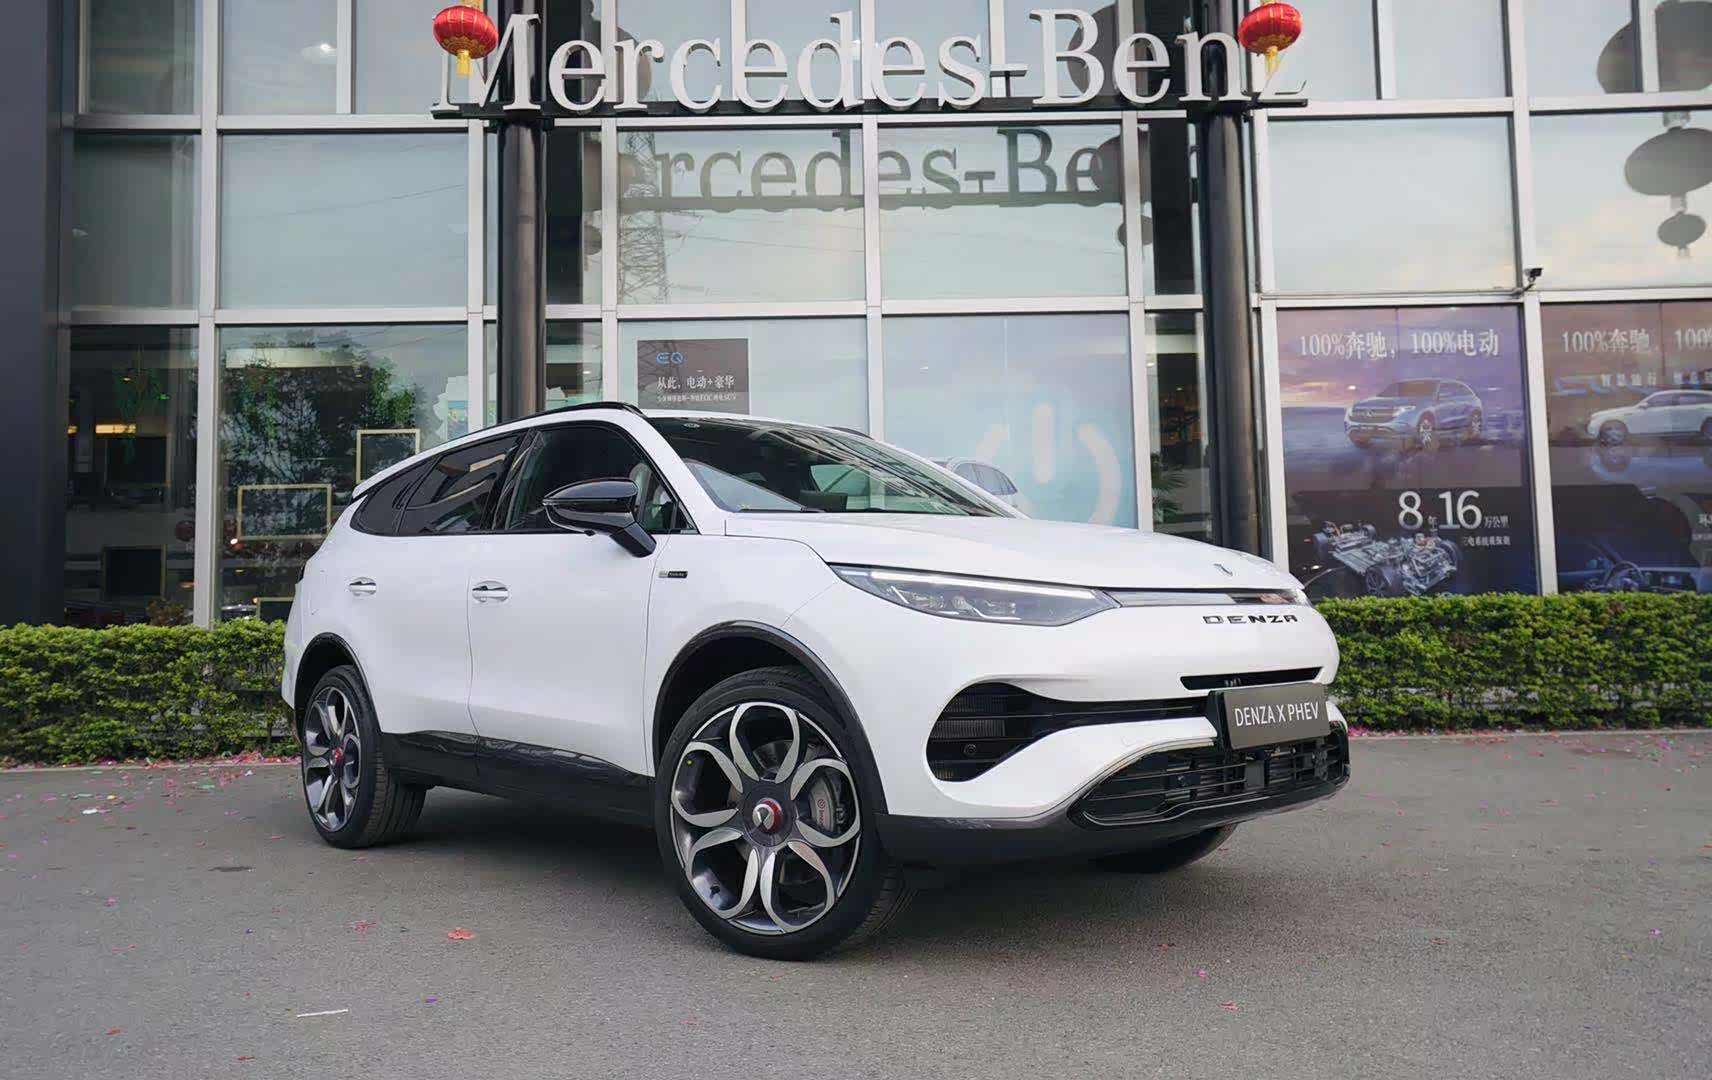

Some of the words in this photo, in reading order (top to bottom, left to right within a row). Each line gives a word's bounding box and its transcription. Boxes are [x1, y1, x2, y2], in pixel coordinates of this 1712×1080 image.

[1203, 614, 1298, 624] DENZA
[1235, 706, 1275, 727] DENZA
[1277, 703, 1285, 721] X
[1288, 701, 1320, 722] PHEV
